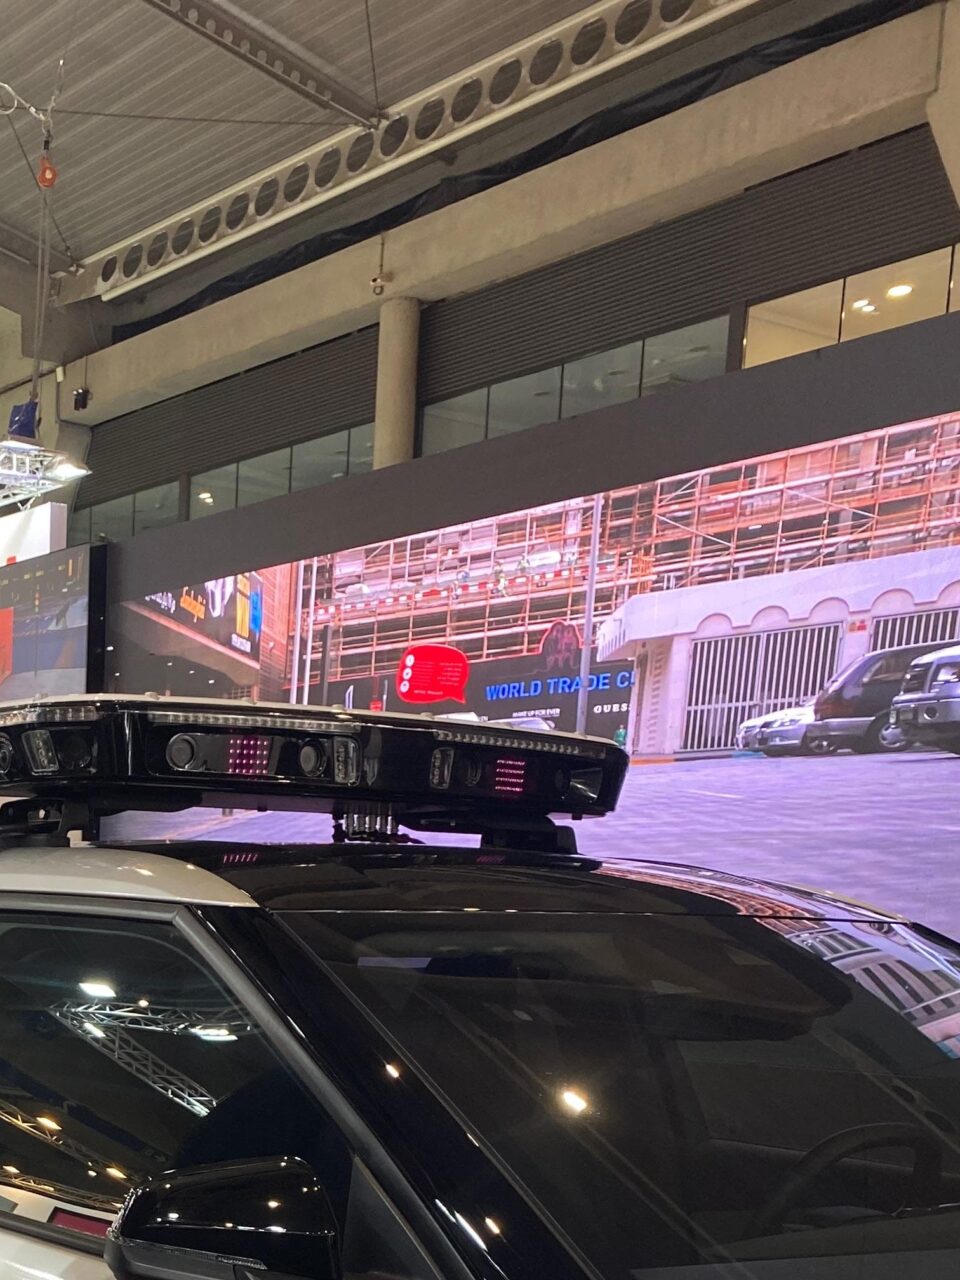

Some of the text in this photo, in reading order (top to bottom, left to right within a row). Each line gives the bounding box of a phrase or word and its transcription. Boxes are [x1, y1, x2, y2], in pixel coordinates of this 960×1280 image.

[485, 680, 542, 701] WORLD
[547, 673, 611, 695] TRADE
[593, 702, 631, 714] GUES
